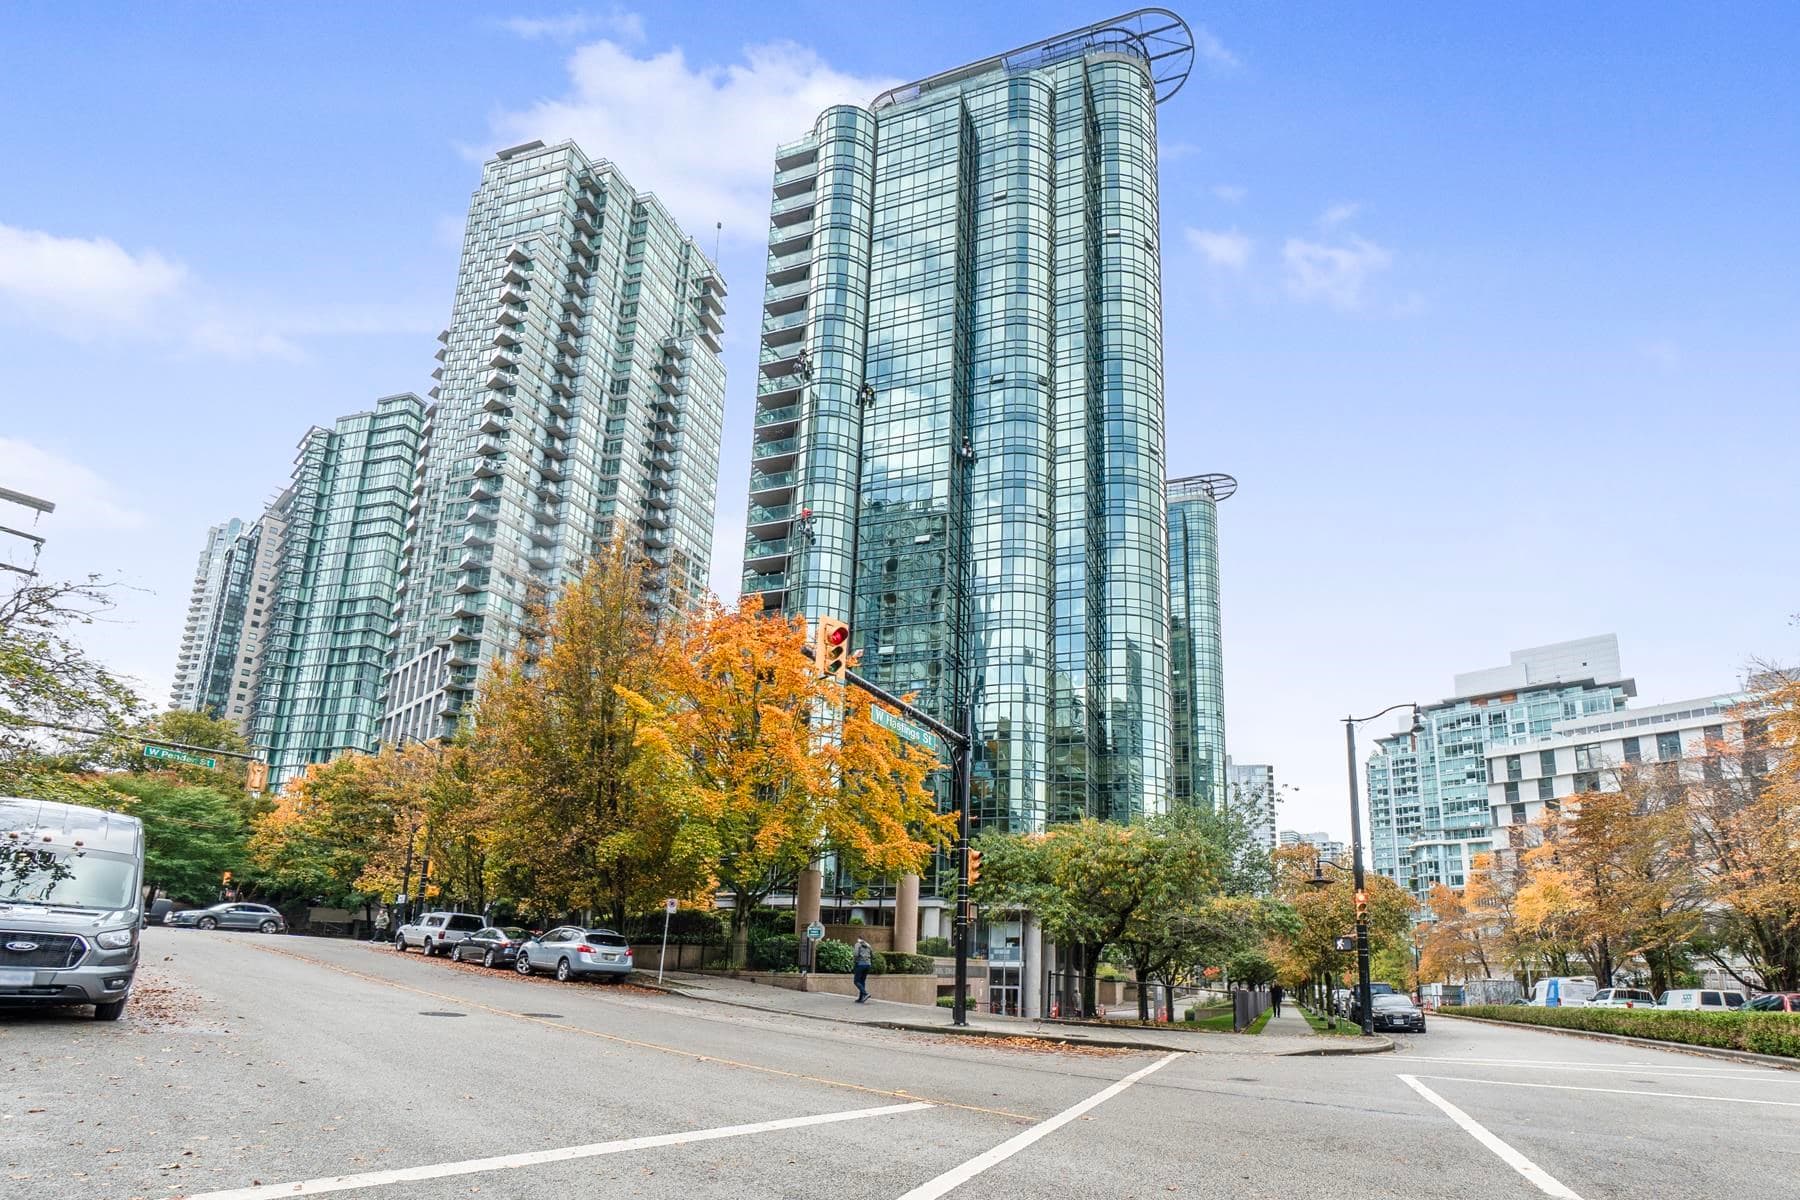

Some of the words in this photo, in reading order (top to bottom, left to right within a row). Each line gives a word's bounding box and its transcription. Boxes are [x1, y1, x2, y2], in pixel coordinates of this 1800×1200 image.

[876, 709, 884, 722] W
[887, 714, 920, 740] Hastings
[923, 733, 931, 745] St
[149, 747, 160, 756] W
